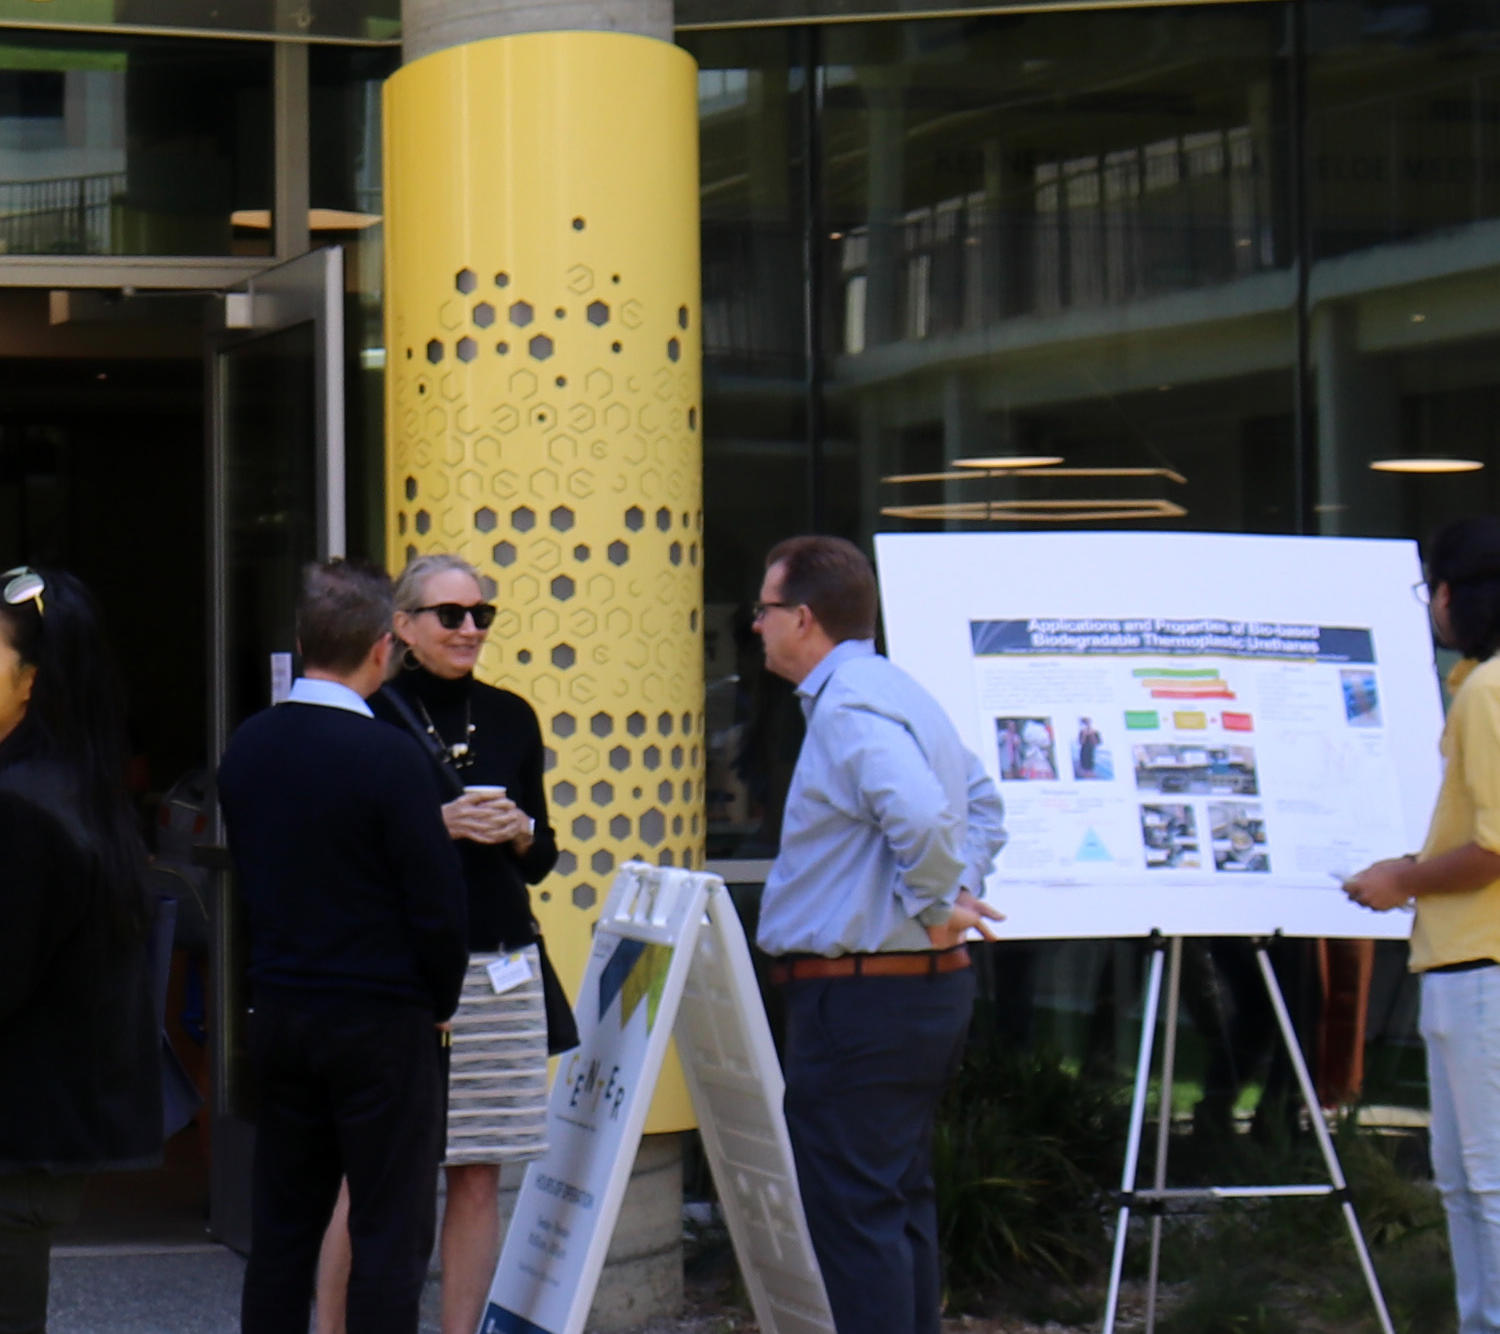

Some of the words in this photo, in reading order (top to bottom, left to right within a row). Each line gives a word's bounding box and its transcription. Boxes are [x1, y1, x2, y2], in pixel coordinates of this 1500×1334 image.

[1027, 618, 1121, 635] Applications
[1123, 619, 1152, 633] and
[1153, 619, 1229, 637] Properties
[1231, 622, 1246, 637] of
[1247, 622, 1320, 640] Bio-based
[1030, 633, 1141, 650] Biodegradable
[1142, 633, 1245, 650] Thermoplastic
[1246, 636, 1320, 653] Urethanes
[565, 1053, 626, 1121] CENTER
